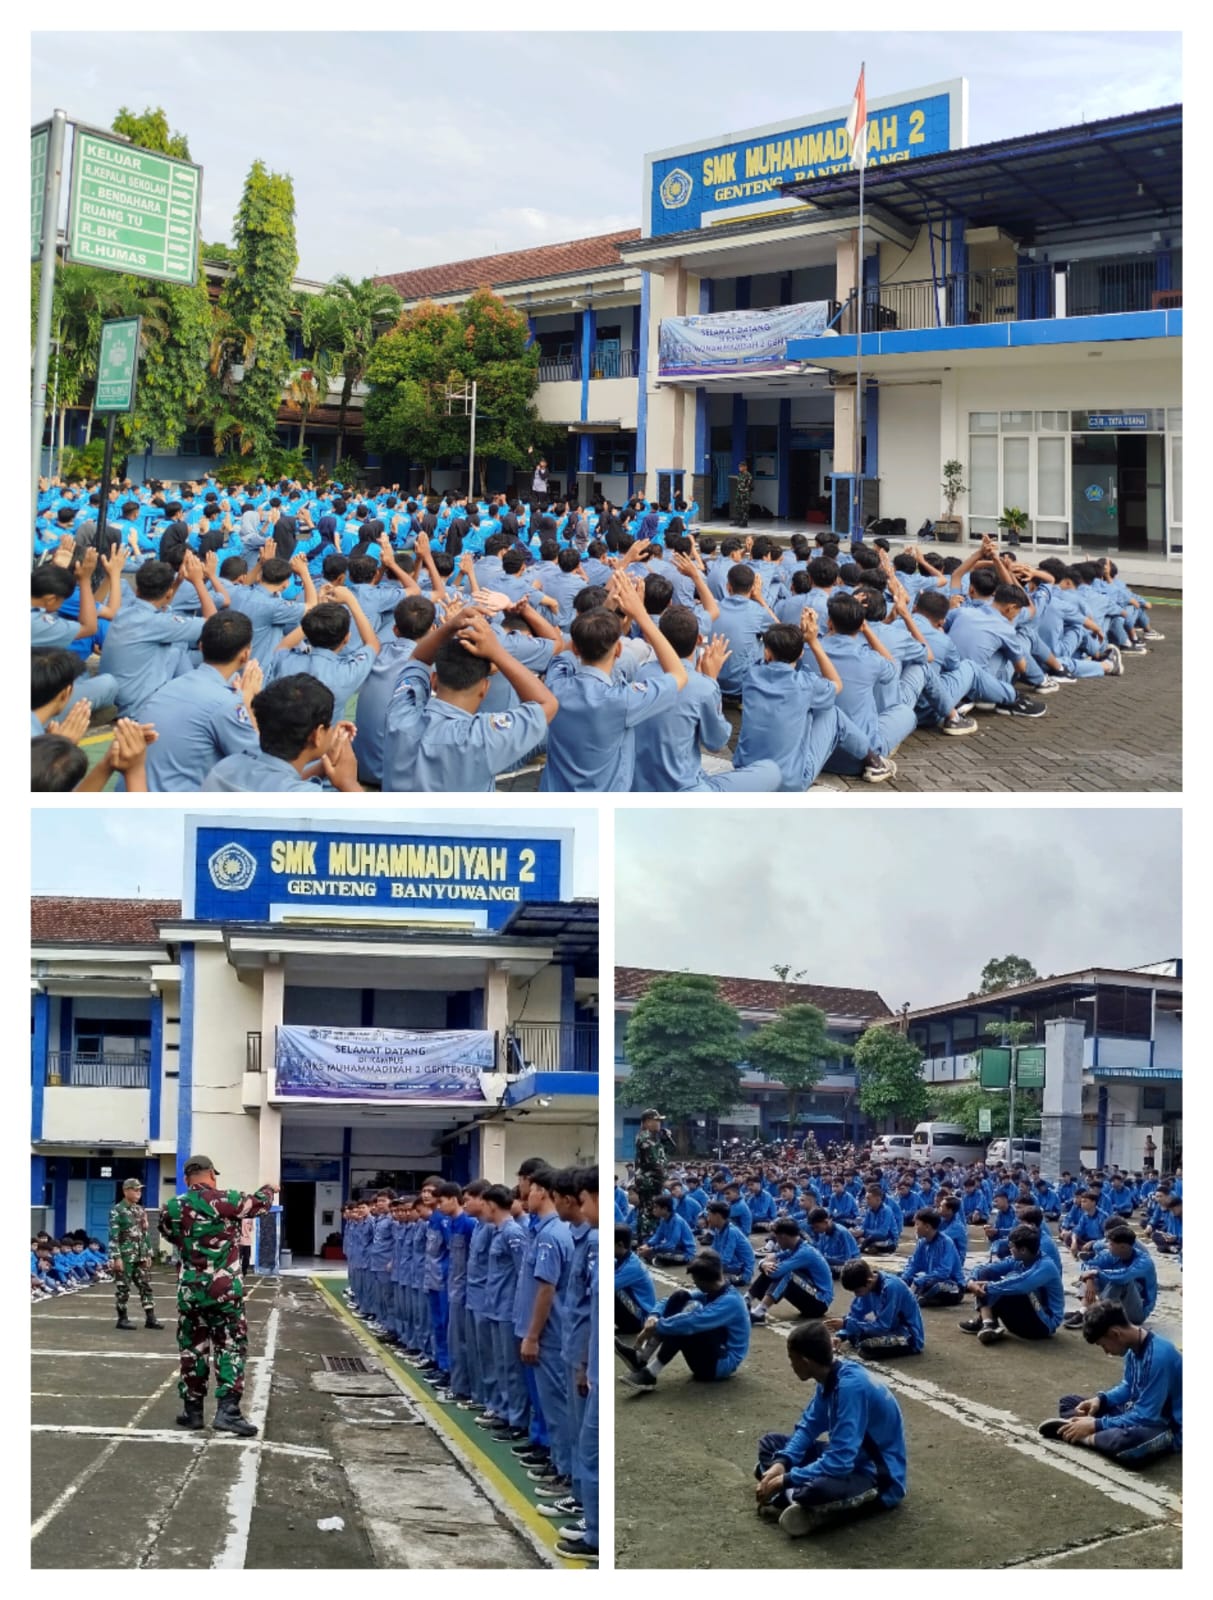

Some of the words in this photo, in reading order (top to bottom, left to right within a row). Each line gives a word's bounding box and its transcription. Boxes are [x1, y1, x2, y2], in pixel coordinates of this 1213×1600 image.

[87, 145, 142, 170] KELUAR
[703, 154, 737, 186] SMK
[745, 115, 898, 177] MUHAMMADAH
[909, 109, 925, 145] 2
[98, 186, 162, 213] BENDAHARA
[128, 178, 167, 197] SEKOLAH
[82, 202, 124, 223] RUANG
[127, 213, 143, 227] TU
[81, 222, 120, 241] R.BK
[80, 241, 147, 265] R.HUMAS
[701, 327, 735, 337] SELAMAT
[271, 841, 317, 875] SMK
[329, 842, 508, 882] MUHAMMADIYAH
[518, 848, 536, 883] 2
[287, 881, 377, 898] GENTENG
[391, 883, 521, 902] BANYUWANGI
[335, 1044, 382, 1055] SELAMAT
[384, 1047, 426, 1056] DATANG
